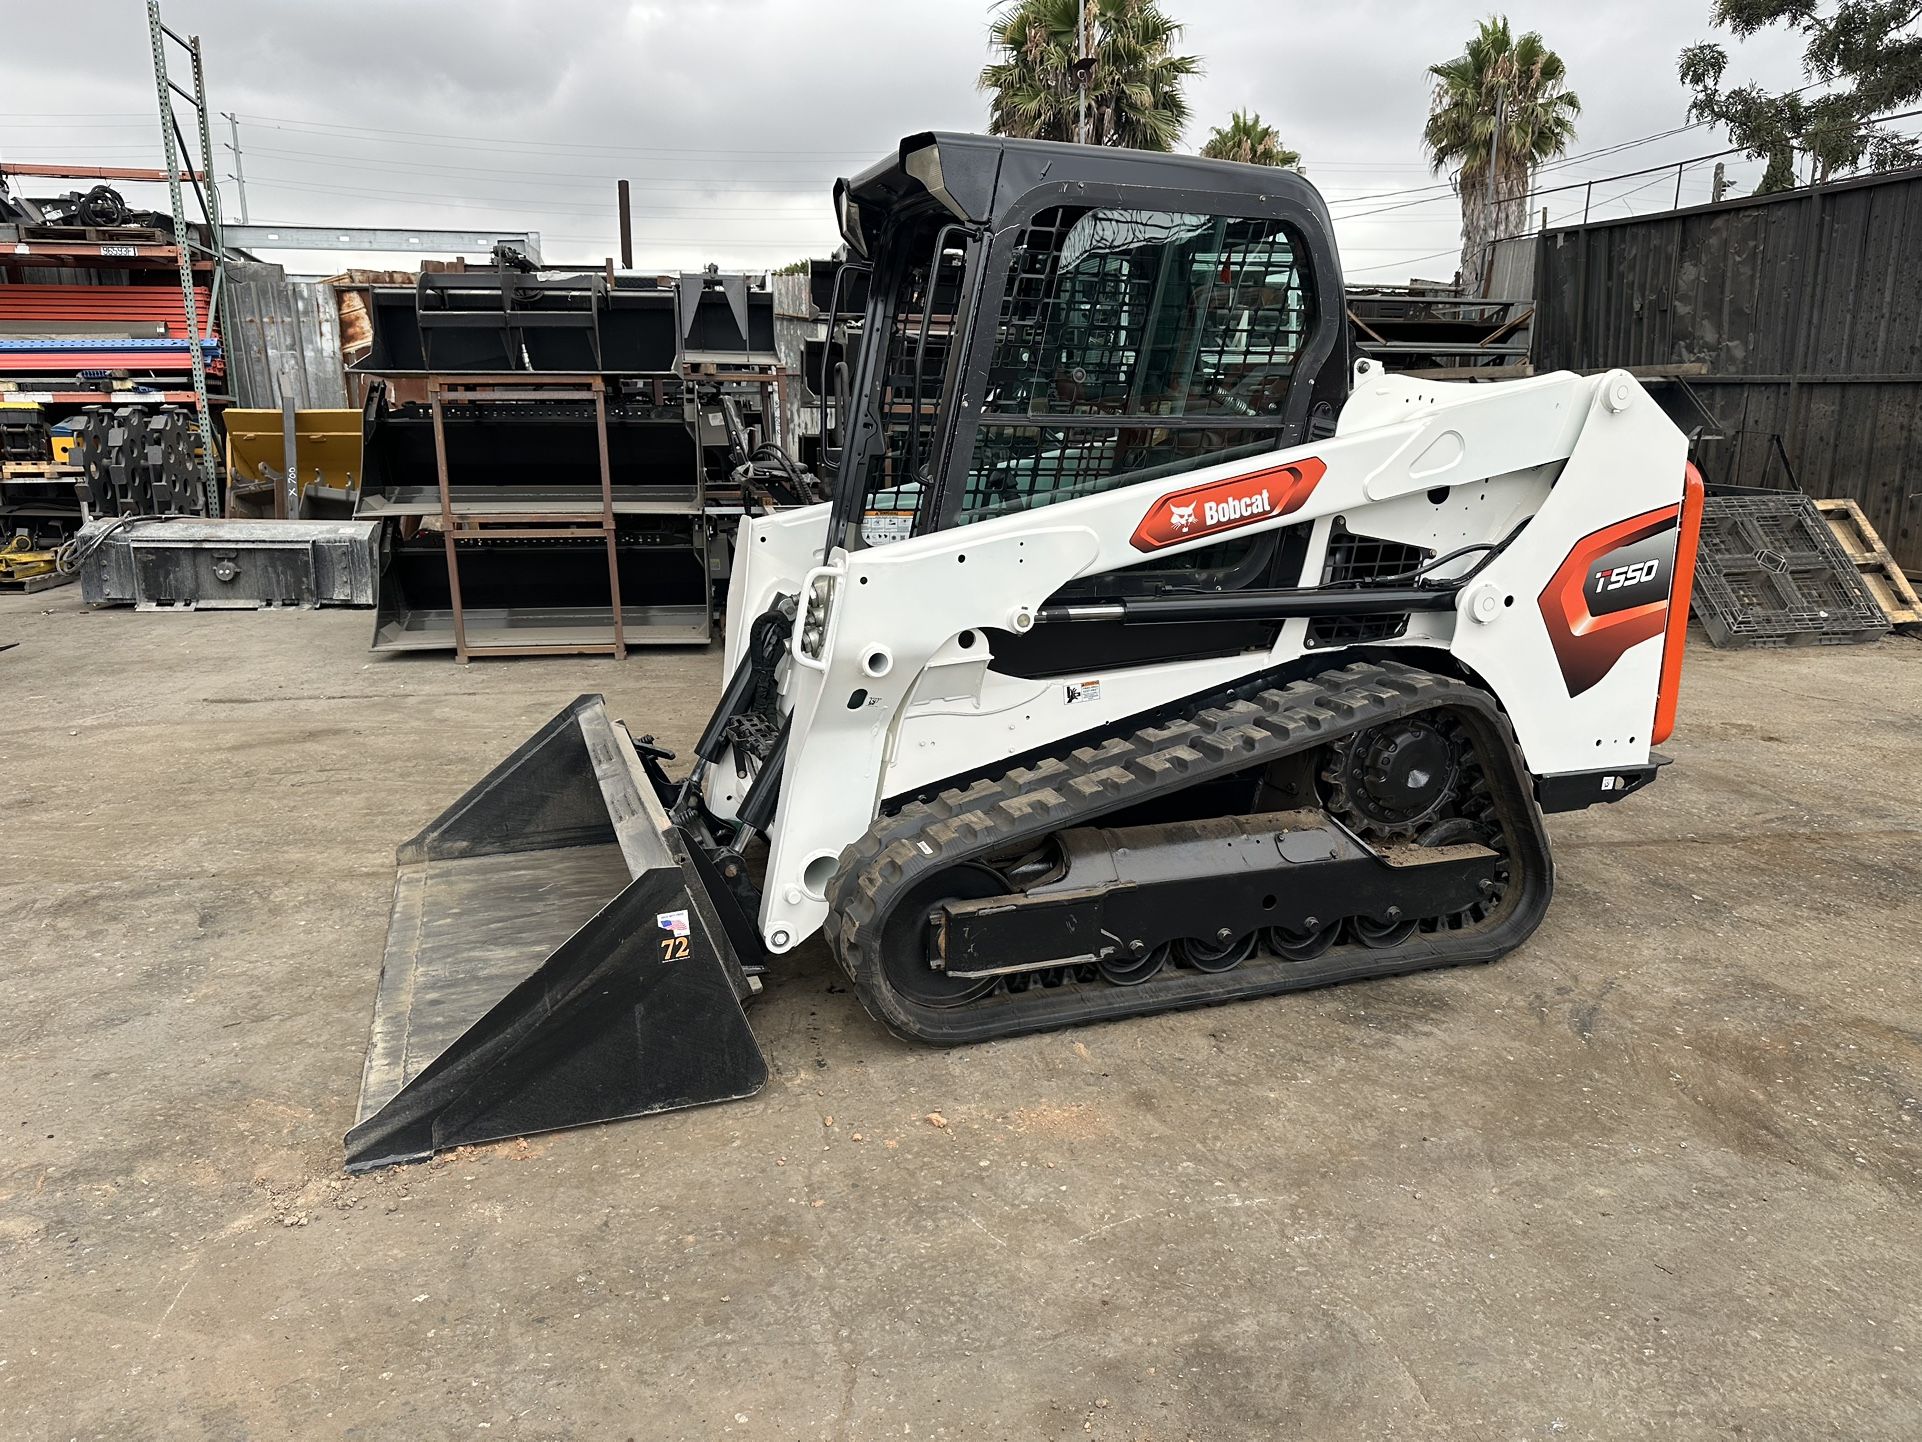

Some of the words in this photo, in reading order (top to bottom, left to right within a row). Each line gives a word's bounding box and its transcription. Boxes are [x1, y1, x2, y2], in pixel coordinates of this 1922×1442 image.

[288, 467, 297, 484] 700
[1204, 489, 1271, 526] Bobcat
[1595, 559, 1660, 593] T550
[660, 936, 690, 960] 72
